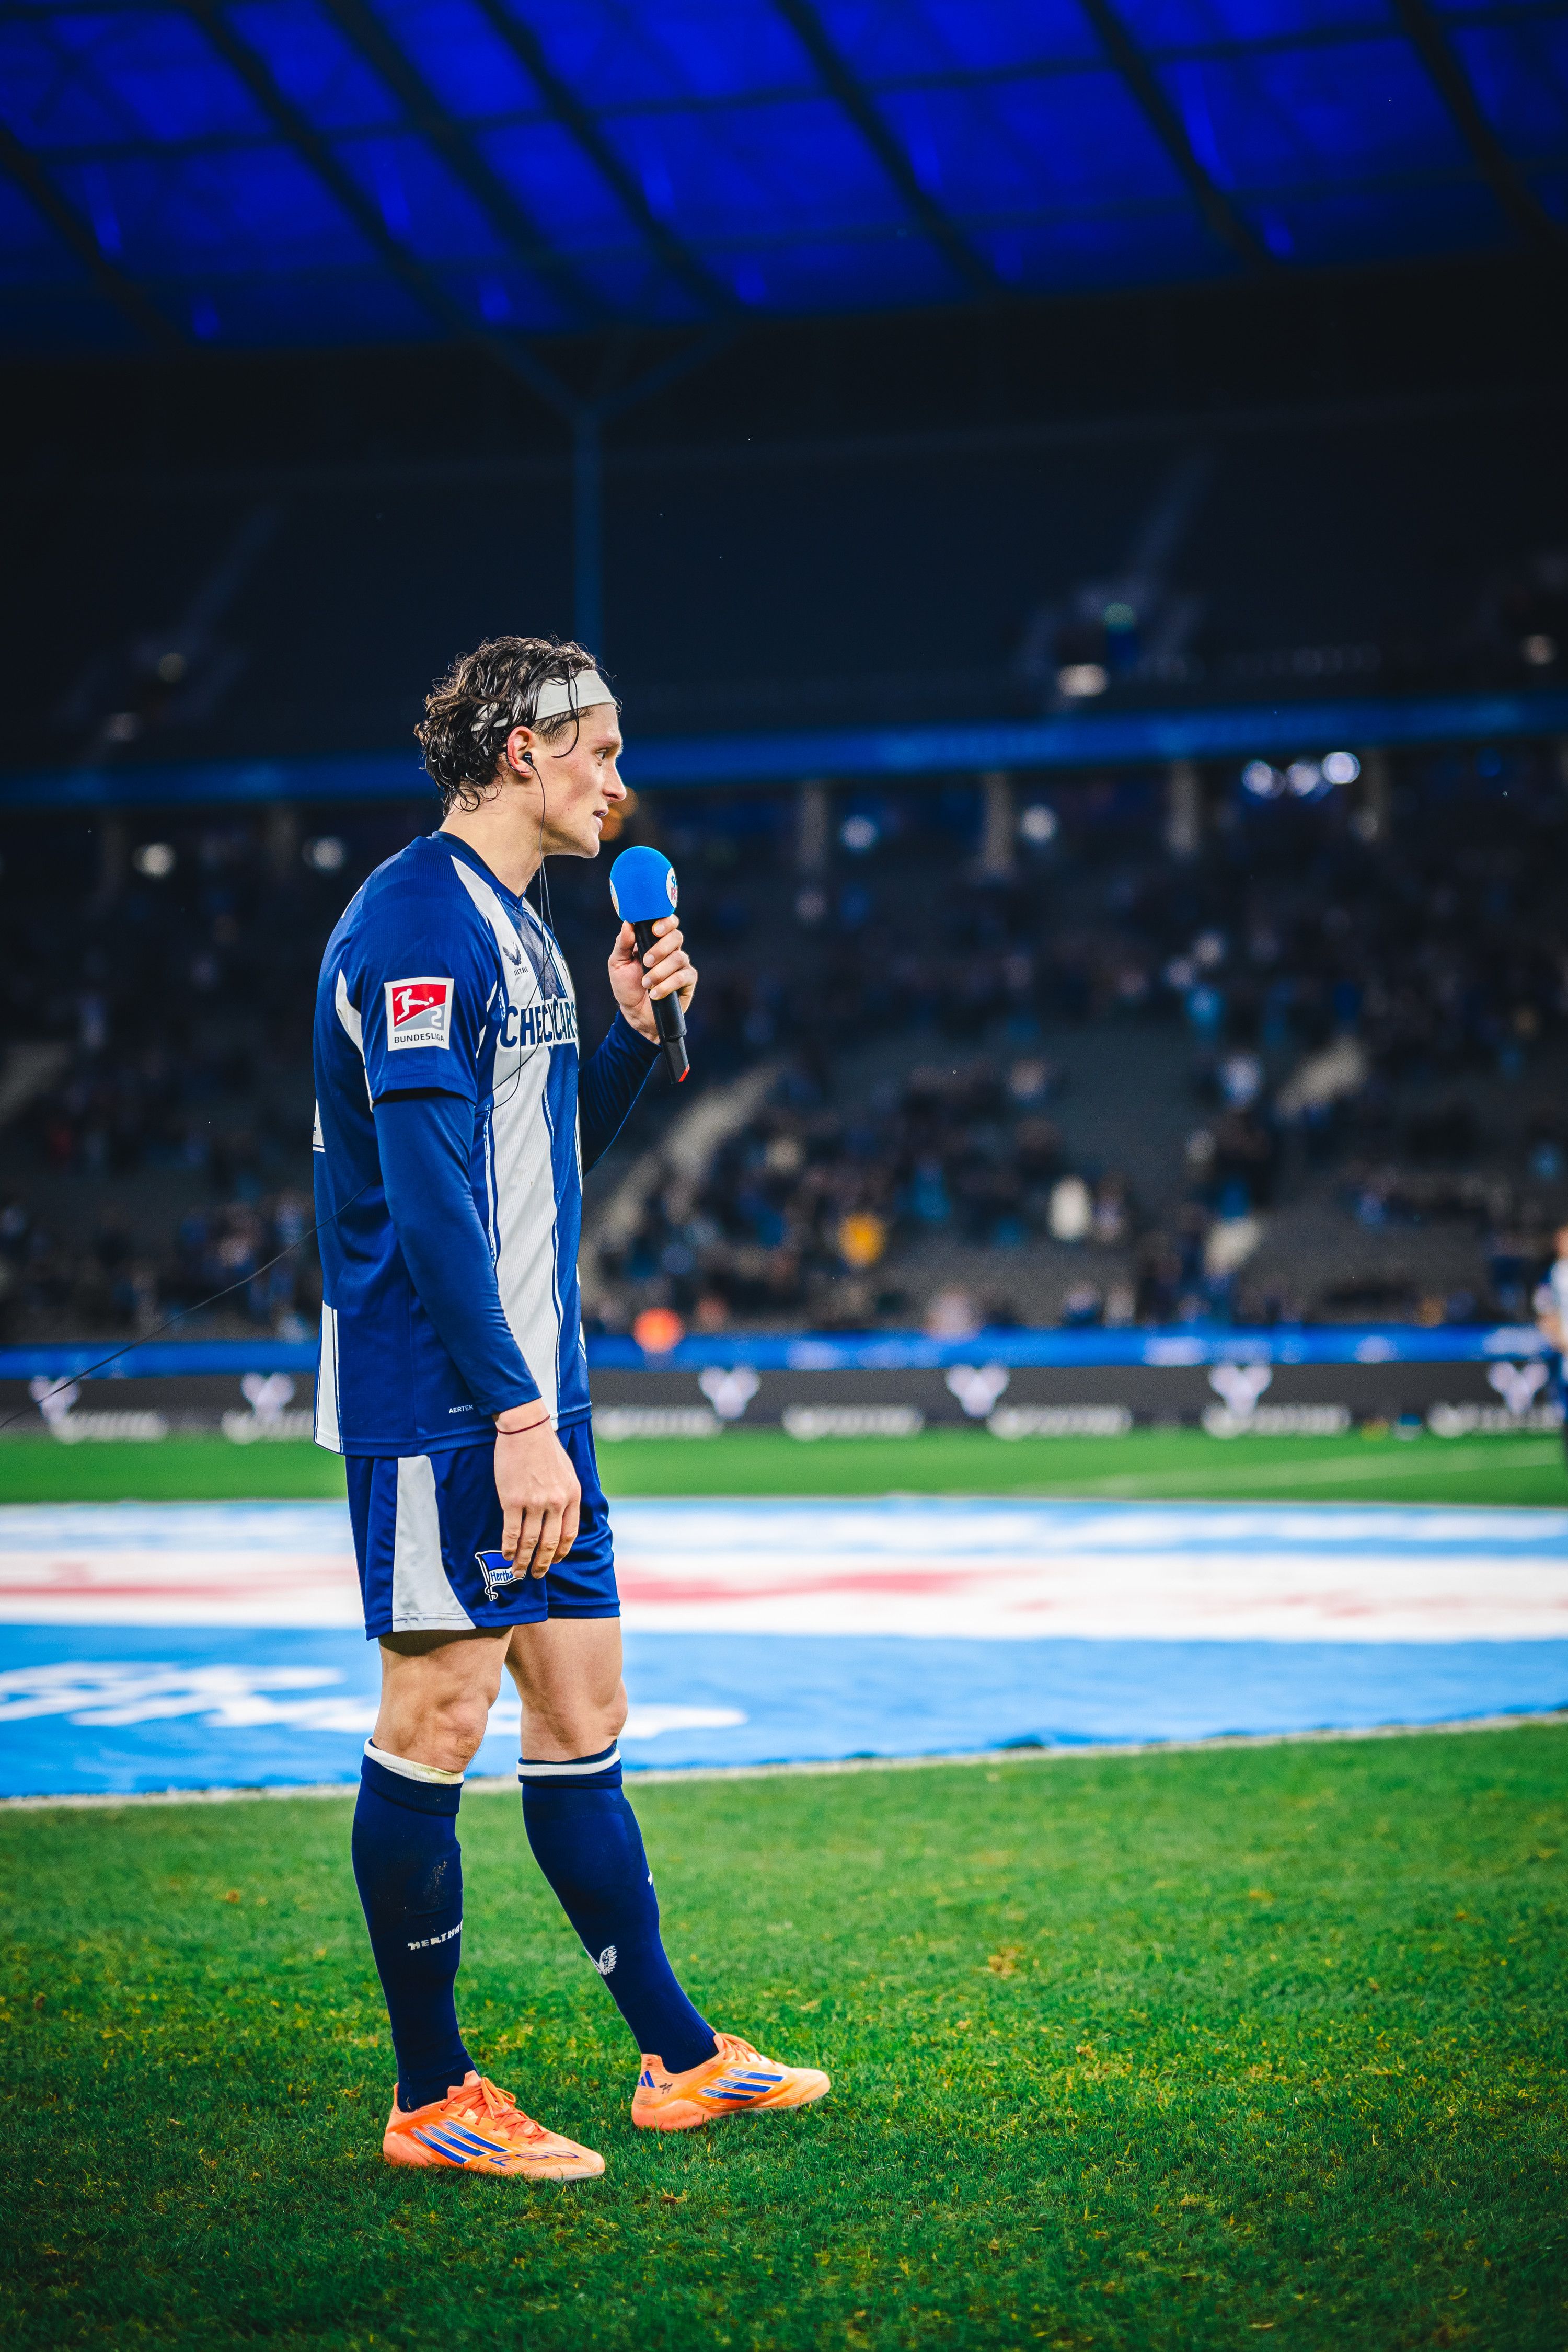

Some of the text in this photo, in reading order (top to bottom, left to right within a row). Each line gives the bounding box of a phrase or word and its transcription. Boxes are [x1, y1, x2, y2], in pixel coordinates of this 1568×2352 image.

[394, 1033, 445, 1043] BUNDESLIGA
[449, 1404, 474, 1414] AERTEK
[490, 1570, 514, 1582] Hertha
